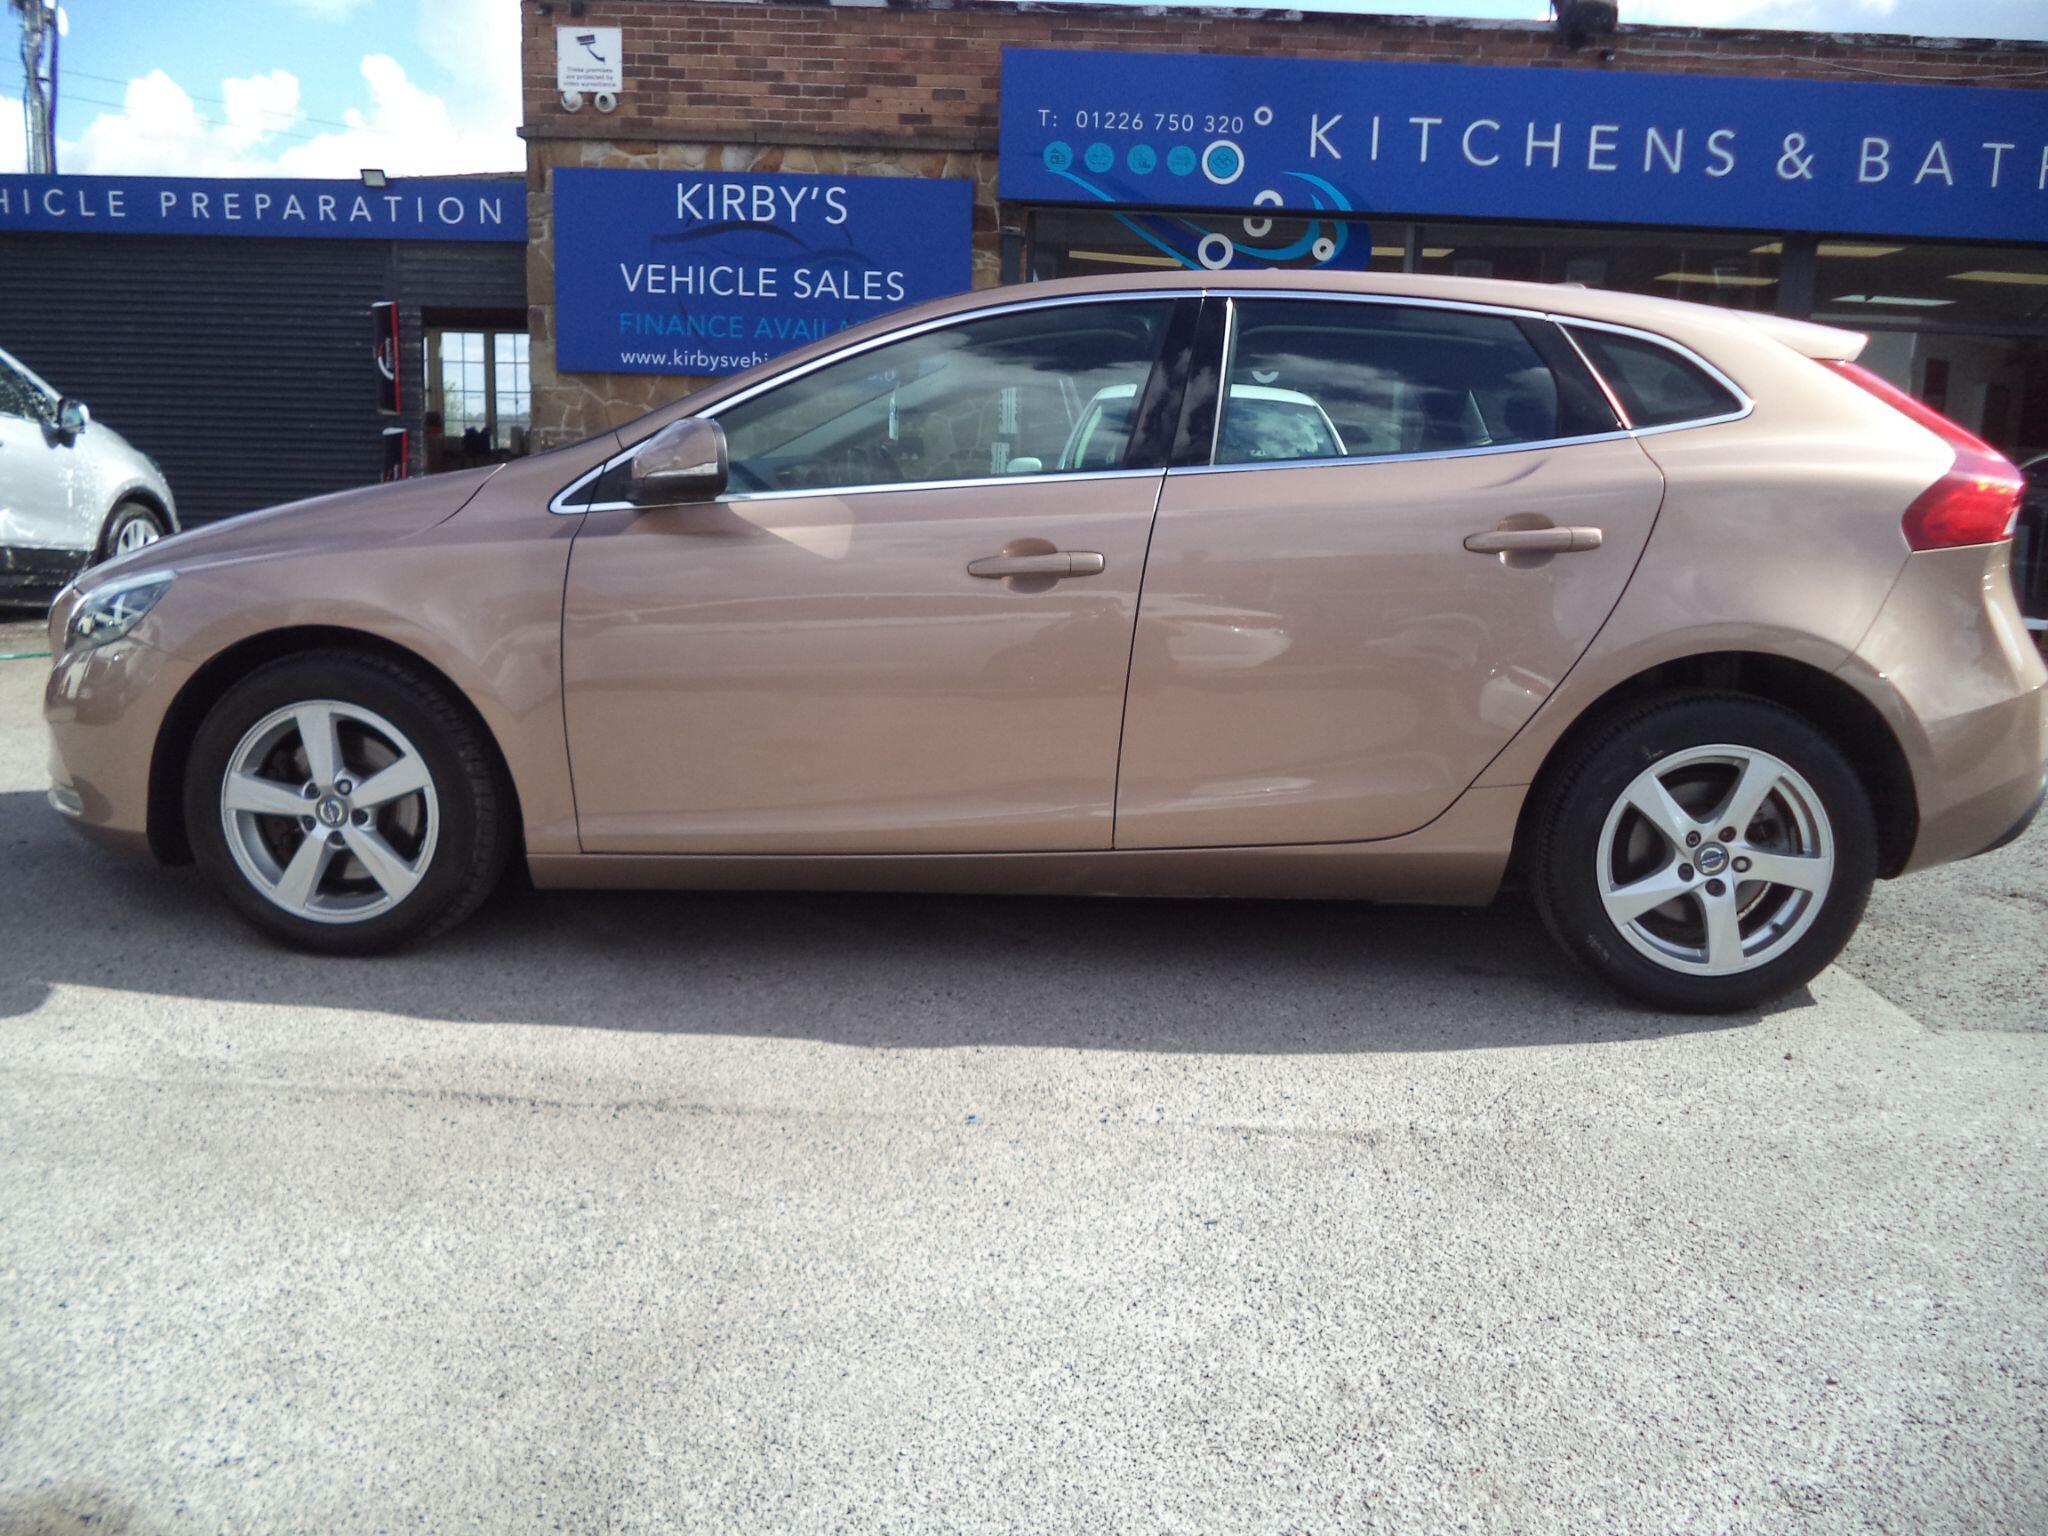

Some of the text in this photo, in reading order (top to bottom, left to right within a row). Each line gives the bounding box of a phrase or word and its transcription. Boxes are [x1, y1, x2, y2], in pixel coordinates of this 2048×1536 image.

[1075, 110, 1144, 131] 01226
[1154, 113, 1195, 133] 750
[1203, 115, 1245, 134] 320
[1309, 113, 2048, 190] KITCHENS & BAT
[160, 190, 503, 225] PREPARATION
[675, 181, 848, 226] KIRBY'S
[620, 262, 906, 302] VEHICLE SALES
[619, 312, 744, 340] FINANCE
